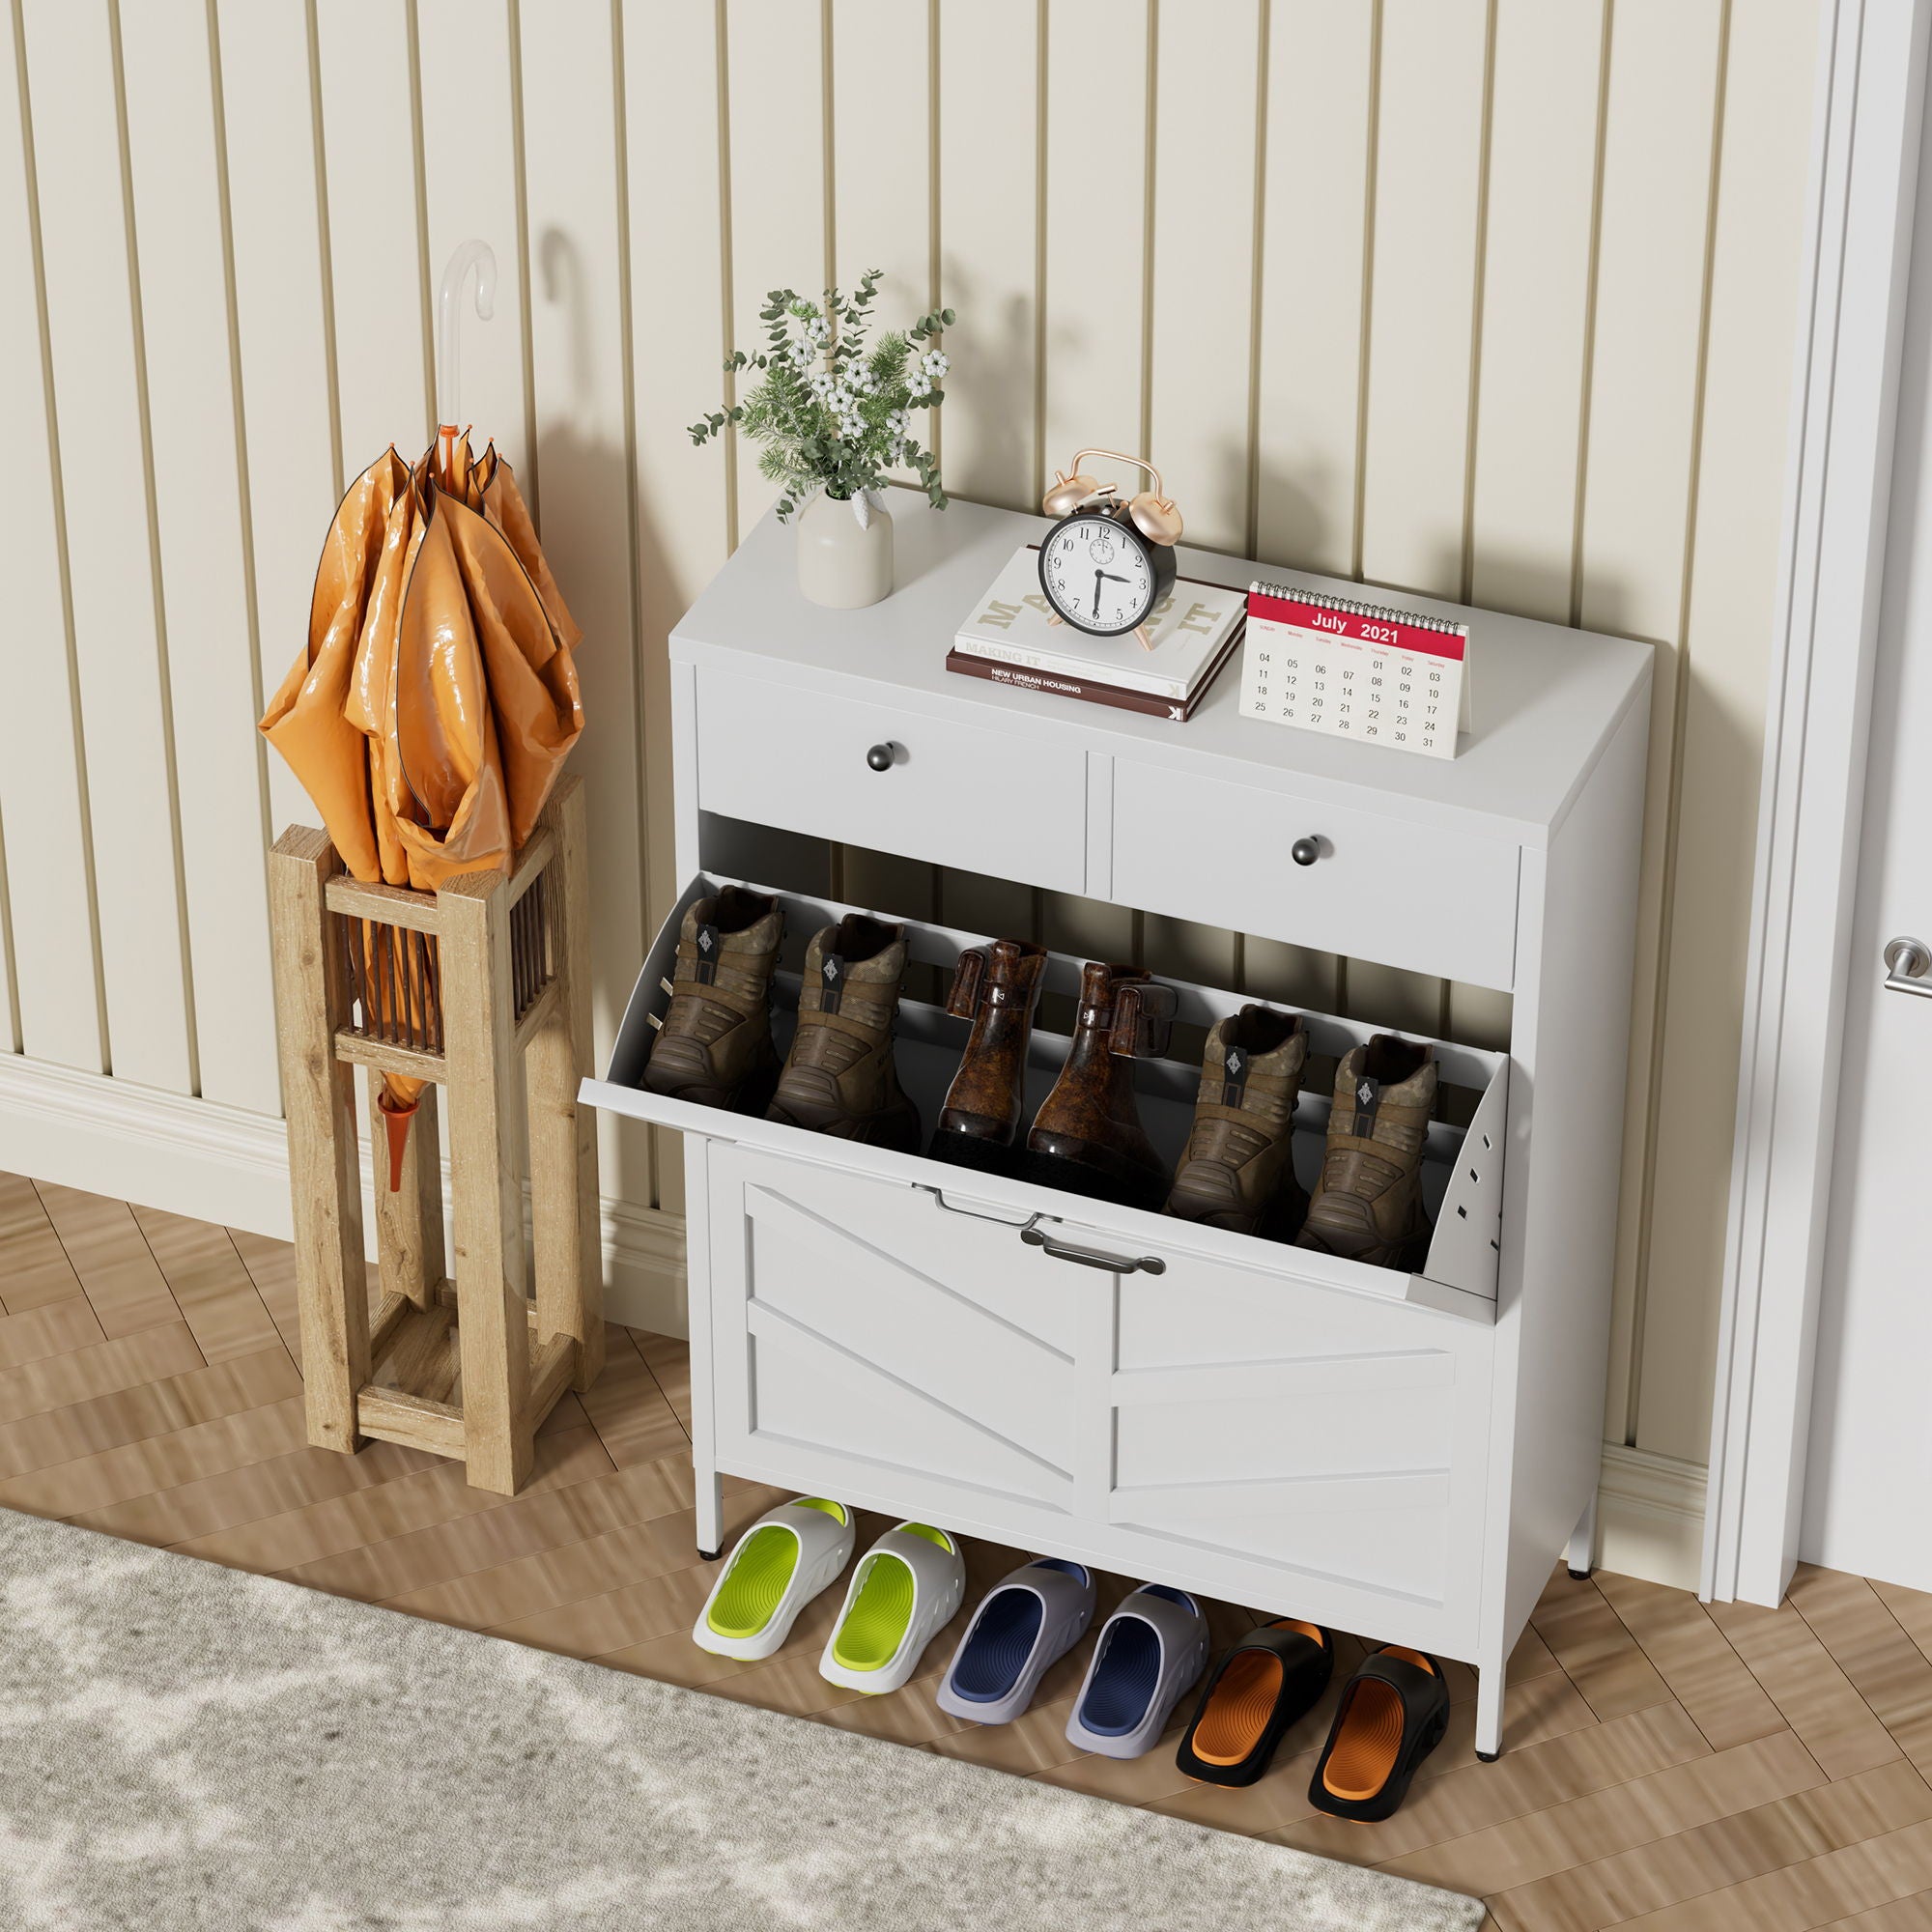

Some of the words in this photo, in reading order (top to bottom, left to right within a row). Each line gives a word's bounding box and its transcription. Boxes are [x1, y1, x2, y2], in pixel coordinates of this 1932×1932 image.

[1080, 527, 1090, 540] 11
[1098, 526, 1110, 540] 12
[1063, 538, 1074, 552] 10
[1122, 537, 1126, 549] 1
[1053, 557, 1062, 569] 9
[1135, 554, 1143, 568] 2
[1057, 579, 1065, 591] 8
[1138, 578, 1147, 590] 3
[1073, 597, 1080, 610] 7
[1130, 597, 1138, 609] 4
[1116, 609, 1123, 620] 5
[1311, 612, 1347, 634] July
[1360, 623, 1398, 644] 2021
[966, 641, 1022, 662] MAKING
[1026, 655, 1041, 666] IT
[1259, 653, 1270, 662] 04
[1287, 658, 1298, 668] 05
[1315, 665, 1326, 674] 06
[1343, 671, 1354, 681] 07
[1371, 677, 1382, 686] 08
[1400, 682, 1410, 692] 09
[1429, 689, 1439, 698] 10
[1373, 660, 1383, 670] 01
[1401, 666, 1412, 676] 02
[1429, 672, 1440, 682] 03
[991, 675, 1014, 684] HILARY
[1014, 679, 1040, 690] FRENCH
[992, 668, 1011, 678] NEW
[1012, 673, 1041, 685] URBAN
[1043, 681, 1081, 694] HOUSING
[1259, 669, 1268, 679] 11
[1287, 676, 1297, 684] 12
[1315, 681, 1324, 691] 13
[1343, 687, 1352, 696] 14
[1371, 694, 1381, 703] 15
[1399, 699, 1409, 709] 16
[1427, 706, 1437, 715] 17
[1257, 685, 1267, 696] 18
[1285, 692, 1295, 701] 19
[1312, 697, 1323, 707] 20
[1340, 703, 1350, 713] 21
[1368, 709, 1379, 719] 22
[1396, 715, 1407, 725] 23
[1424, 721, 1435, 731] 24
[1255, 701, 1266, 711] 25
[1283, 708, 1294, 717] 26
[1310, 713, 1321, 724] 27
[1338, 719, 1350, 729] 28
[1366, 725, 1378, 735] 29
[1394, 732, 1406, 741] 30
[1422, 738, 1433, 748] 31
